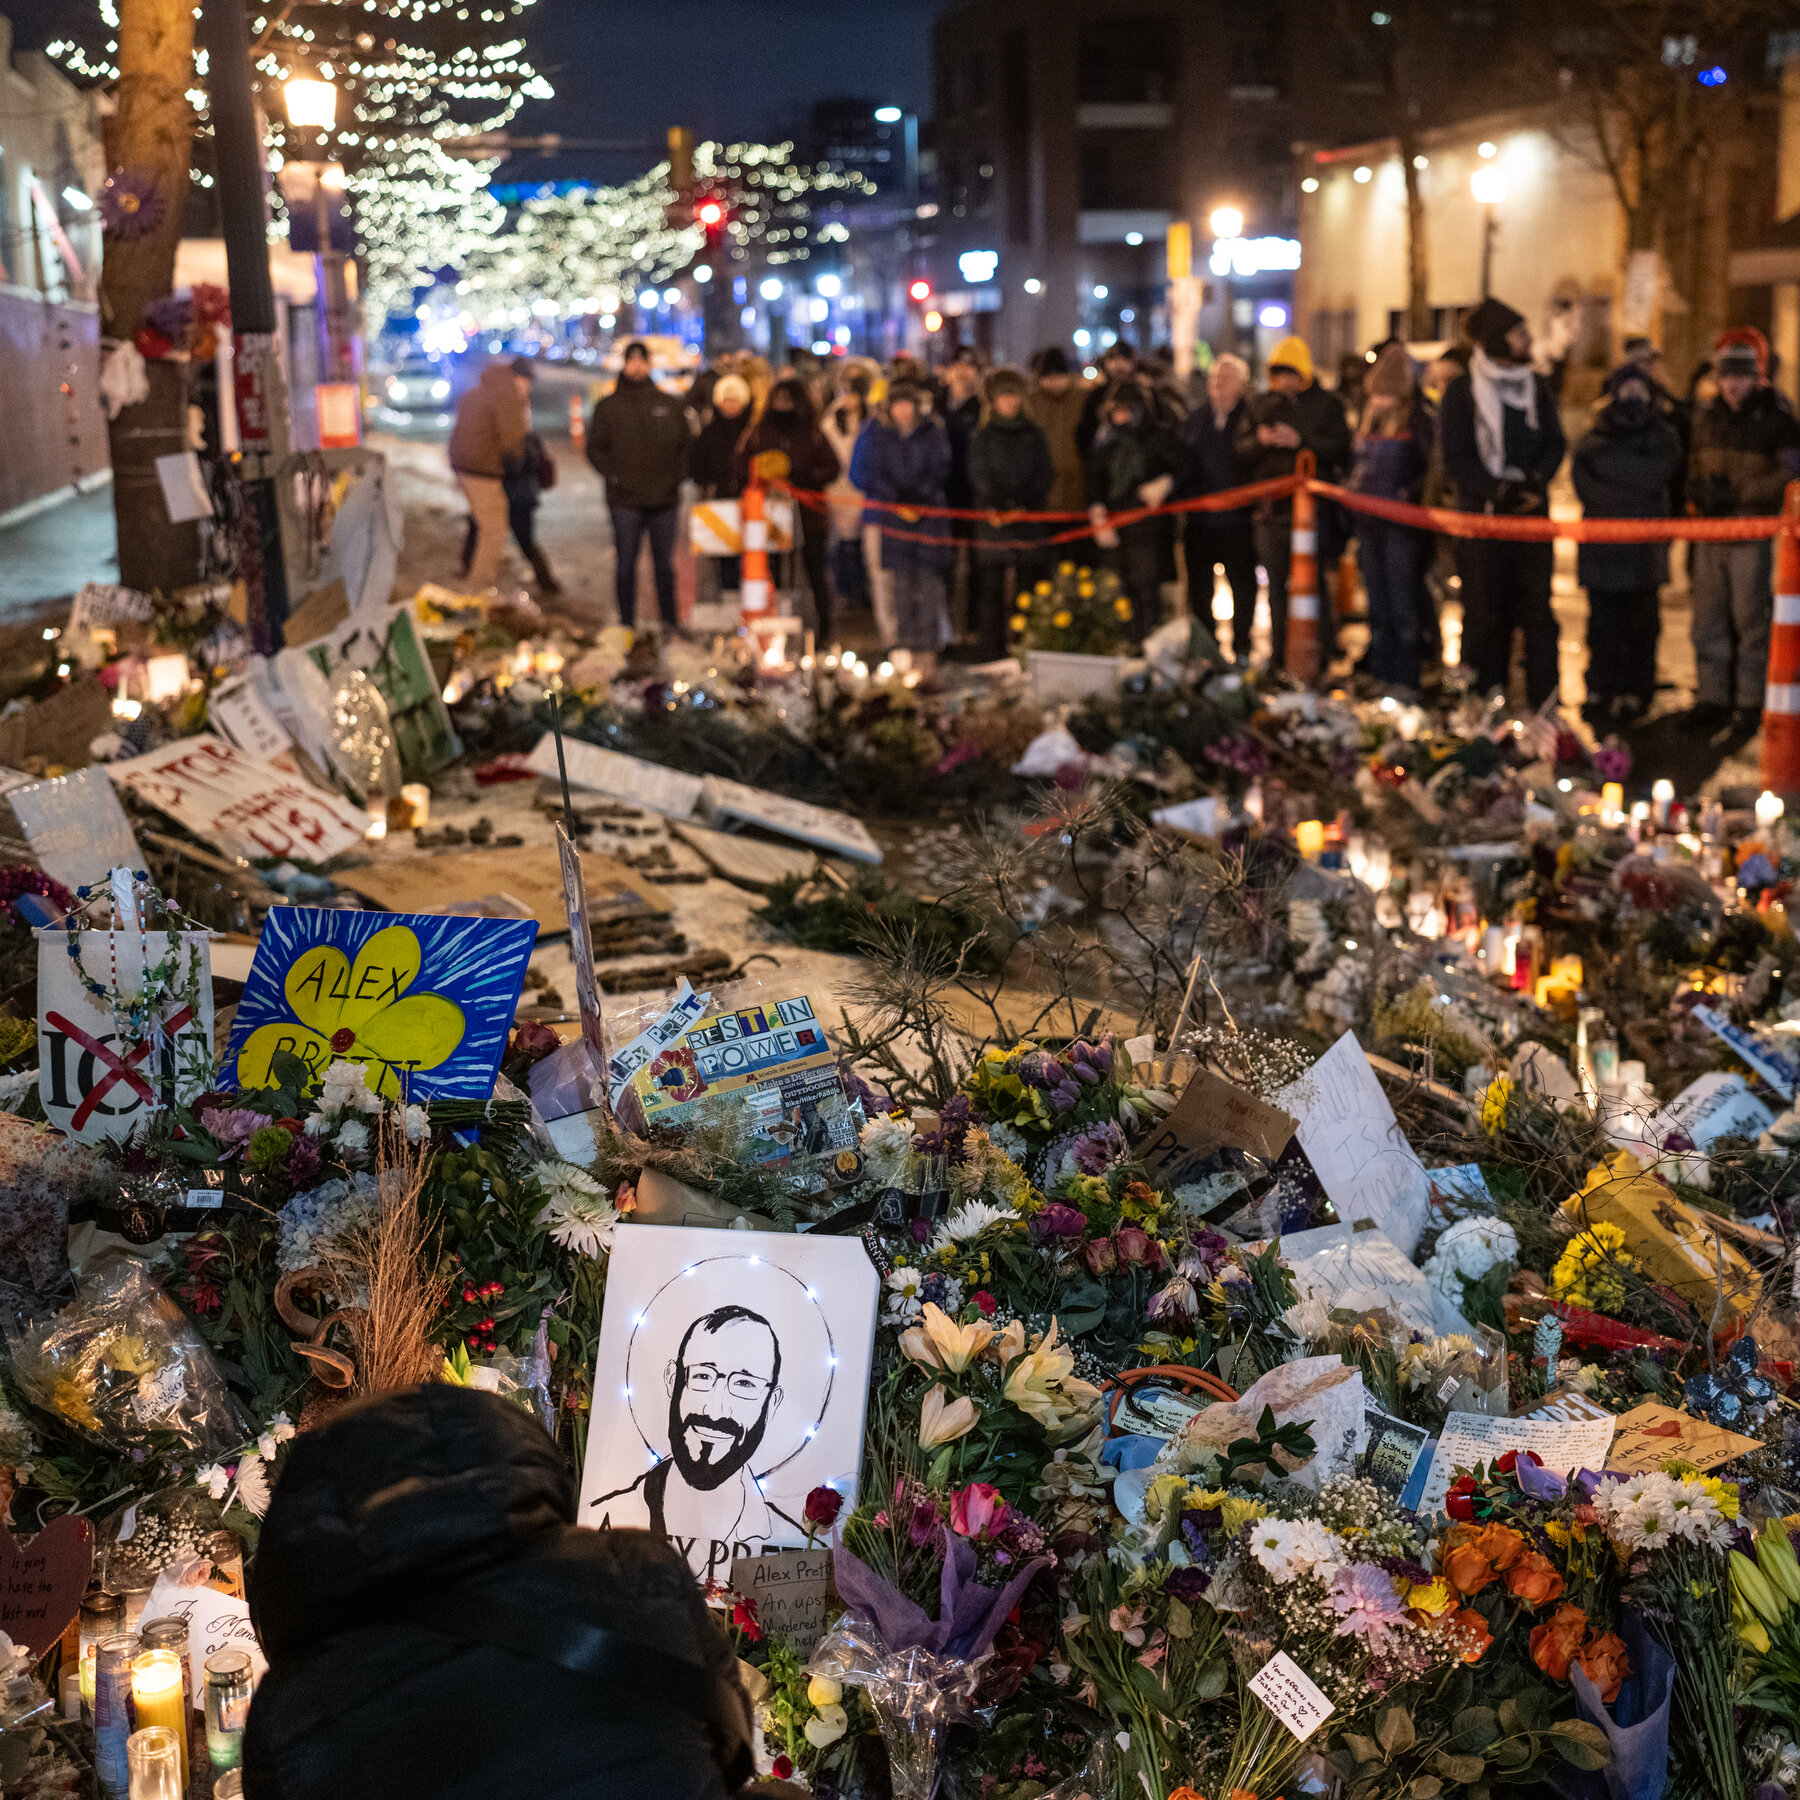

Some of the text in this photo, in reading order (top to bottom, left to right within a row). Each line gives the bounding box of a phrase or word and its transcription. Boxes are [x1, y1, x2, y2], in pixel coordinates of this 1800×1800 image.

[297, 958, 411, 1002] ALEX
[686, 997, 815, 1050] REST IN
[609, 993, 707, 1100] ALEX PRETTI
[702, 1029, 816, 1075] POWER
[758, 1078, 784, 1091] Make
[790, 1064, 838, 1081] Difference
[759, 1068, 778, 1078] SCHOOL
[784, 1078, 838, 1099] OUTDOORSY
[784, 1088, 841, 1109] Bike/Hike/Paddle
[1380, 1453, 1408, 1470] REST
[22, 1557, 46, 1575] going
[753, 1564, 791, 1586] Alex
[7, 1576, 34, 1594] have
[2, 1600, 48, 1622] last word
[761, 1592, 842, 1615] An upstan
[762, 1615, 818, 1634] Murdered
[1263, 1671, 1275, 1682] not
[1271, 1661, 1286, 1677] Your
[1307, 1701, 1321, 1718] were
[1256, 1674, 1279, 1701] Justice
[1290, 1712, 1305, 1729] Alex
